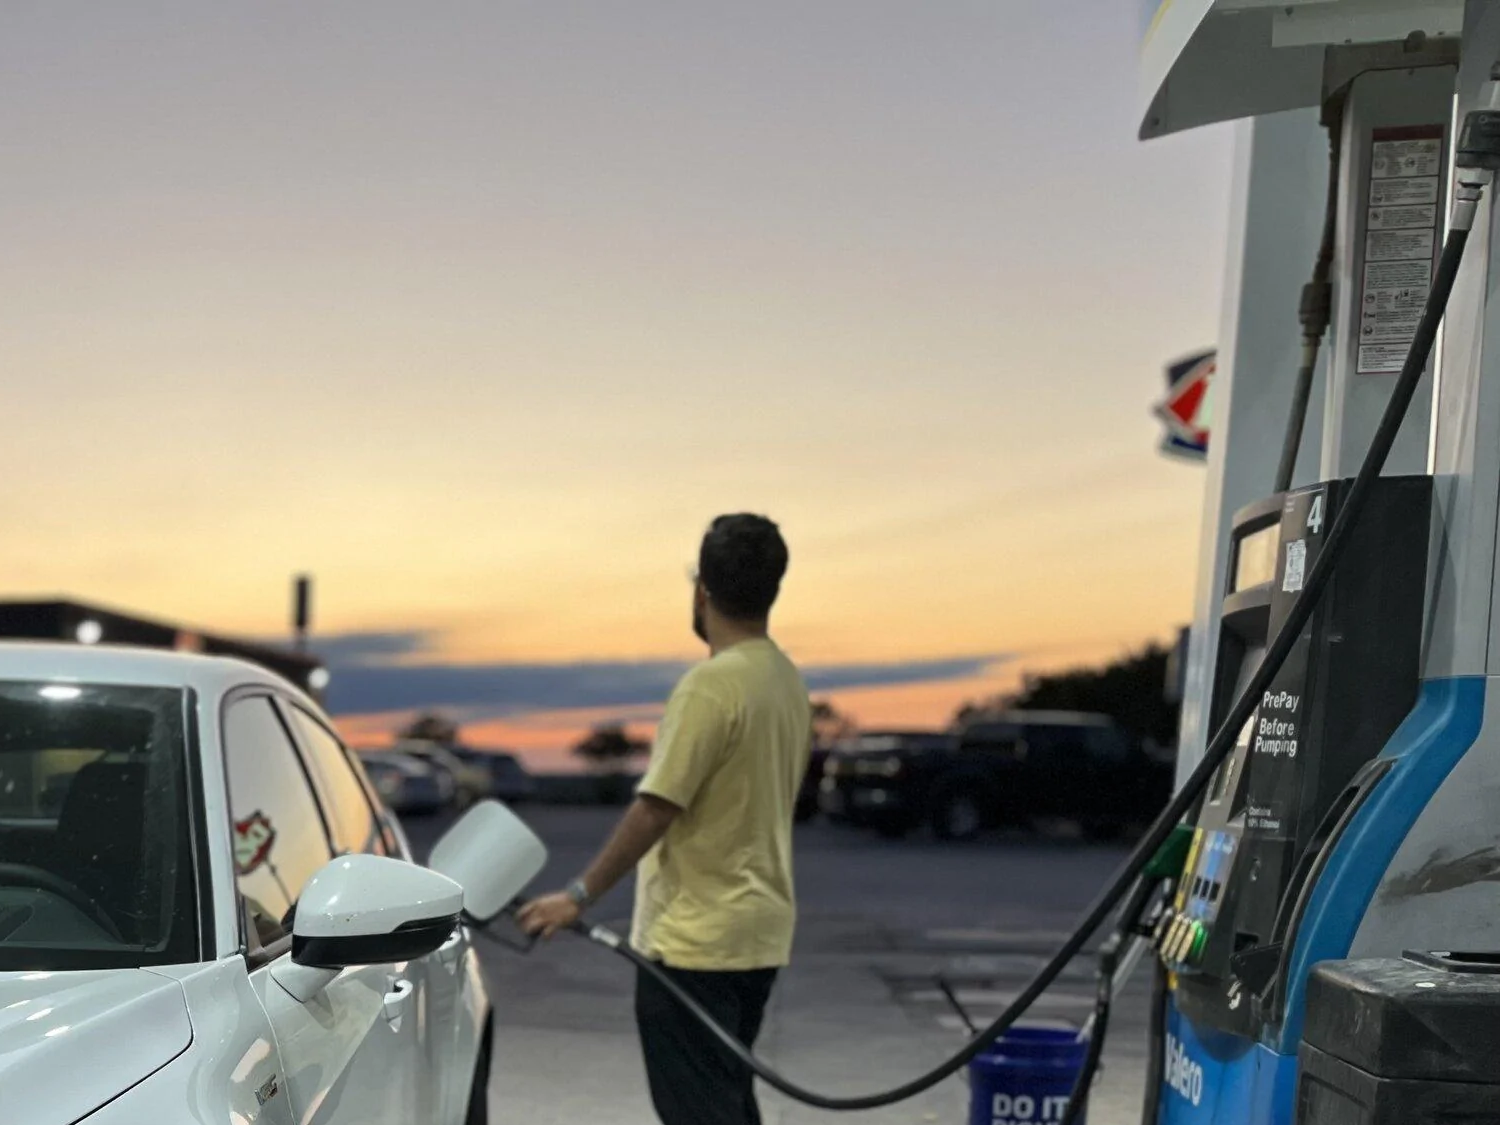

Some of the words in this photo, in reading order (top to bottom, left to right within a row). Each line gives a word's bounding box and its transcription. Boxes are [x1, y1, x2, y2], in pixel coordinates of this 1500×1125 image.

[1306, 495, 1322, 534] 4
[1262, 691, 1300, 713] PrePay
[1259, 718, 1295, 737] Before
[1254, 736, 1298, 758] Pumping
[1165, 1031, 1202, 1107] Valero
[991, 1092, 1035, 1120] DO
